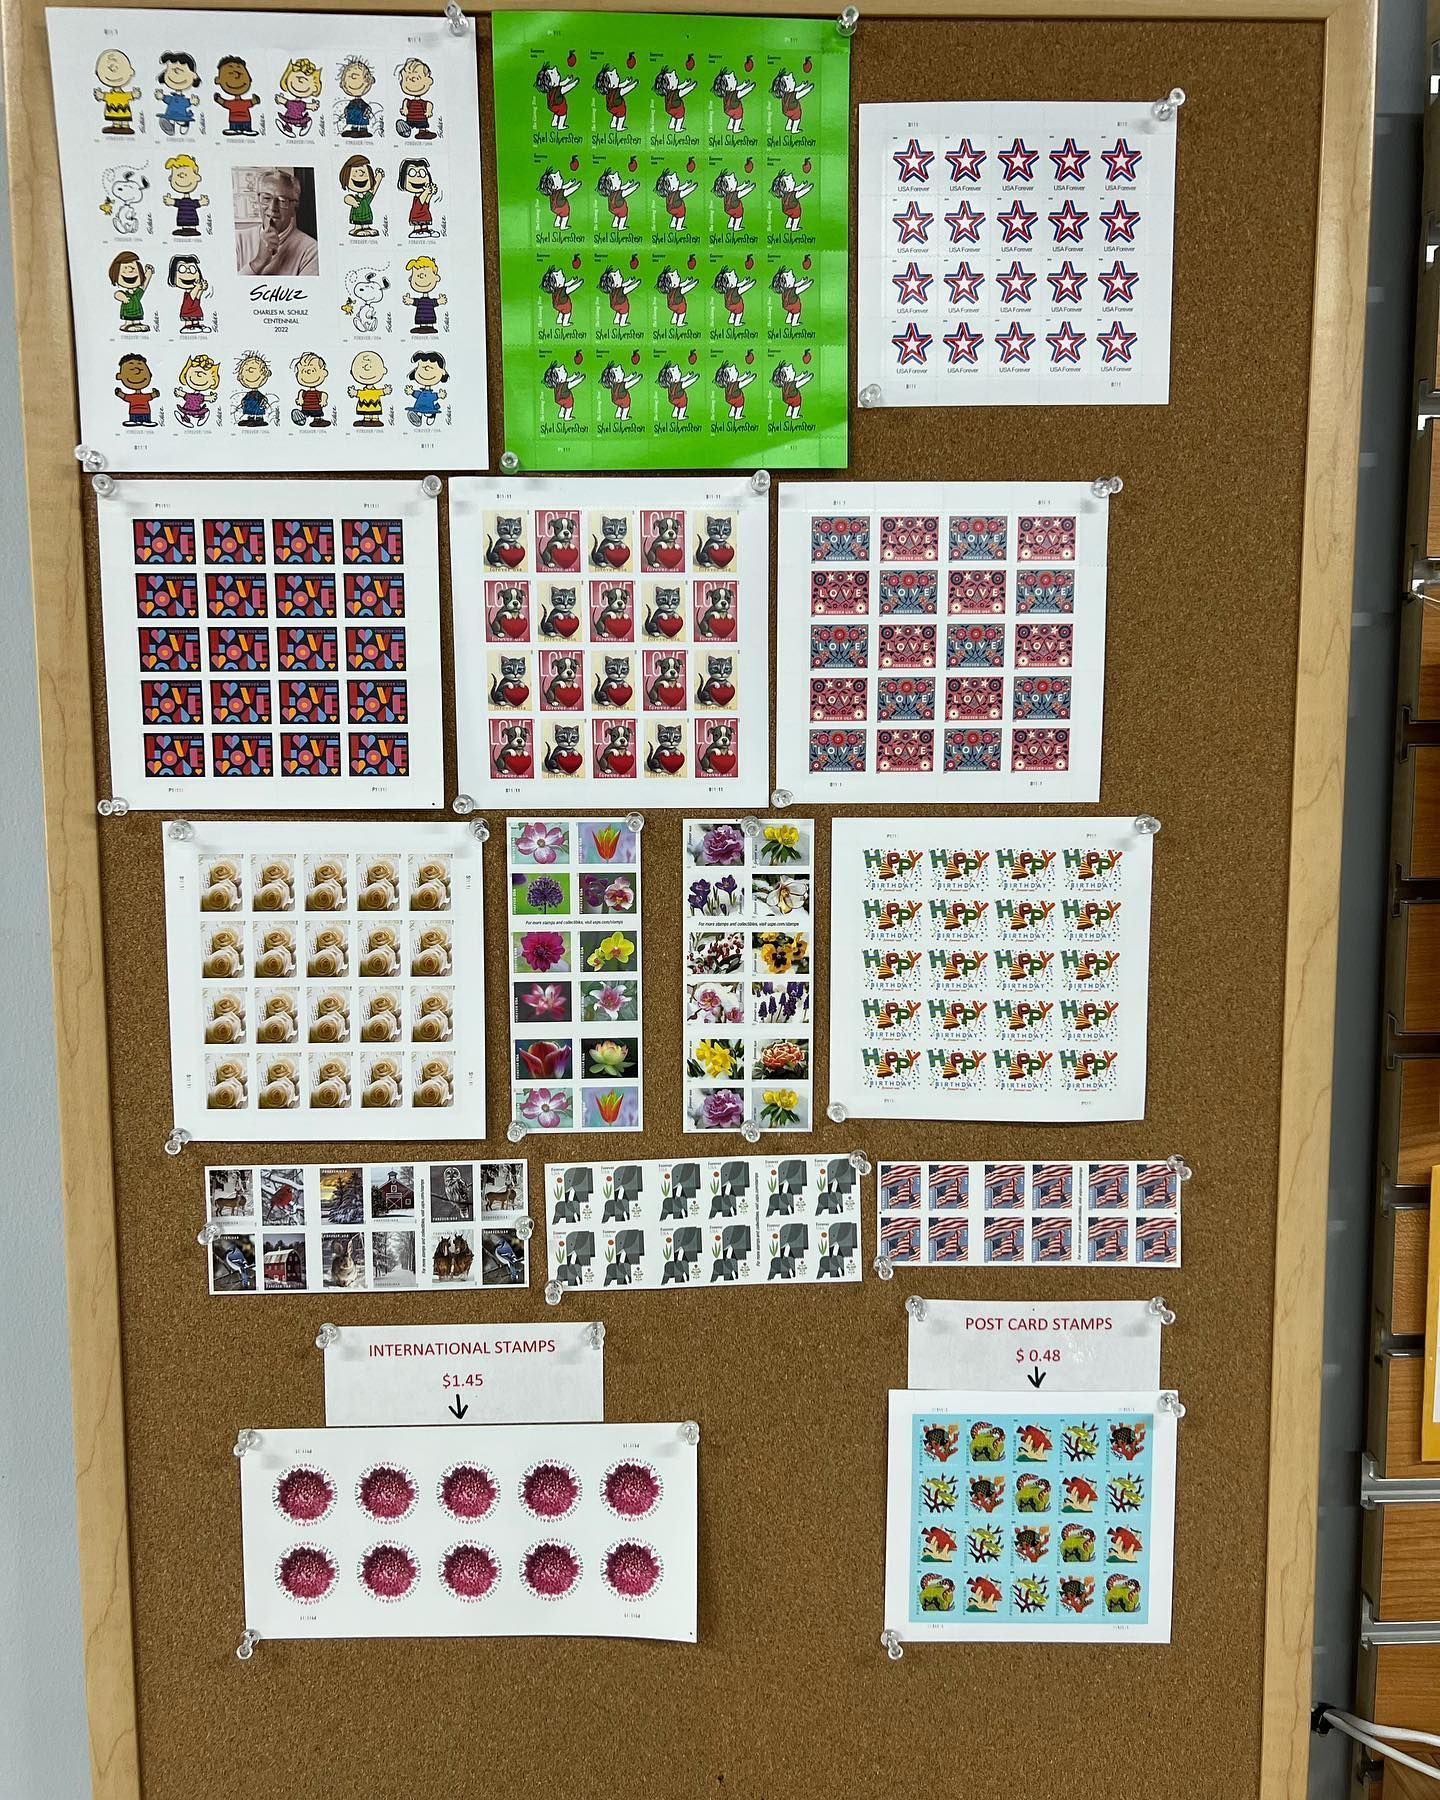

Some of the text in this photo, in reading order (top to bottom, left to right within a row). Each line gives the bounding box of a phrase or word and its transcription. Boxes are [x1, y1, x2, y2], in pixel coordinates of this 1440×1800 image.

[250, 284, 308, 302] SCHULZ
[820, 534, 862, 543] LOVE
[889, 534, 931, 544] LOVE
[958, 534, 999, 543] LOVE
[1026, 534, 1067, 543] LOVE
[819, 588, 861, 598] LOVE
[888, 588, 929, 597] LOVE
[956, 588, 998, 597] LOVE
[1024, 588, 1066, 597] LOVE
[819, 642, 860, 651] LOVE
[887, 642, 929, 651] LOVE
[955, 641, 997, 651] LOVE
[1023, 641, 1065, 651] LOVE
[818, 694, 860, 704] LOVE
[886, 694, 928, 703] LOVE
[954, 694, 996, 703] LOVE
[1022, 693, 1064, 703] LOVE
[817, 746, 859, 755] LOVE
[886, 745, 927, 755] LOVE
[952, 745, 994, 755] LOVE
[1020, 745, 1062, 754] LOVE
[966, 1318, 1112, 1330] POST CARD STAMPS
[370, 1340, 555, 1356] INTERNATIONAL STAMPS
[1016, 1348, 1060, 1363] $ 0.48
[443, 1373, 483, 1388] $1.45
